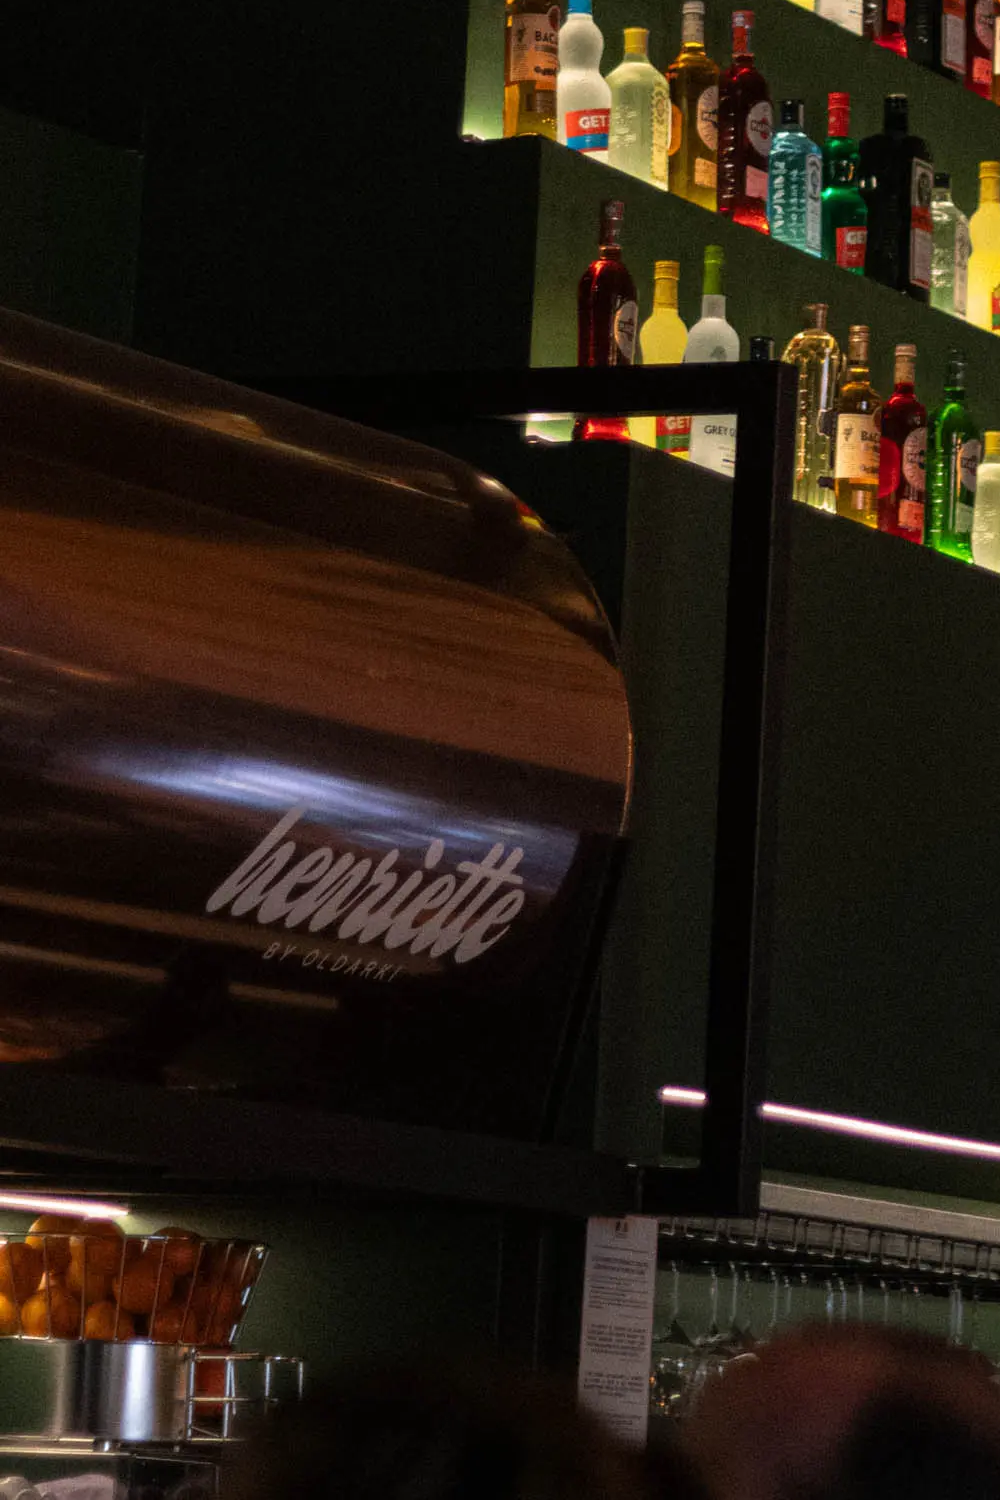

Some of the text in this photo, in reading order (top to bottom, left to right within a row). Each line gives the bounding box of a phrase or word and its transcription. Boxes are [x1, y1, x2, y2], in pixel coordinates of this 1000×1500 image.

[578, 115, 608, 129] GET
[845, 230, 866, 244] GE
[703, 423, 728, 436] GREY
[205, 797, 527, 965] henriette
[262, 941, 297, 963] BY
